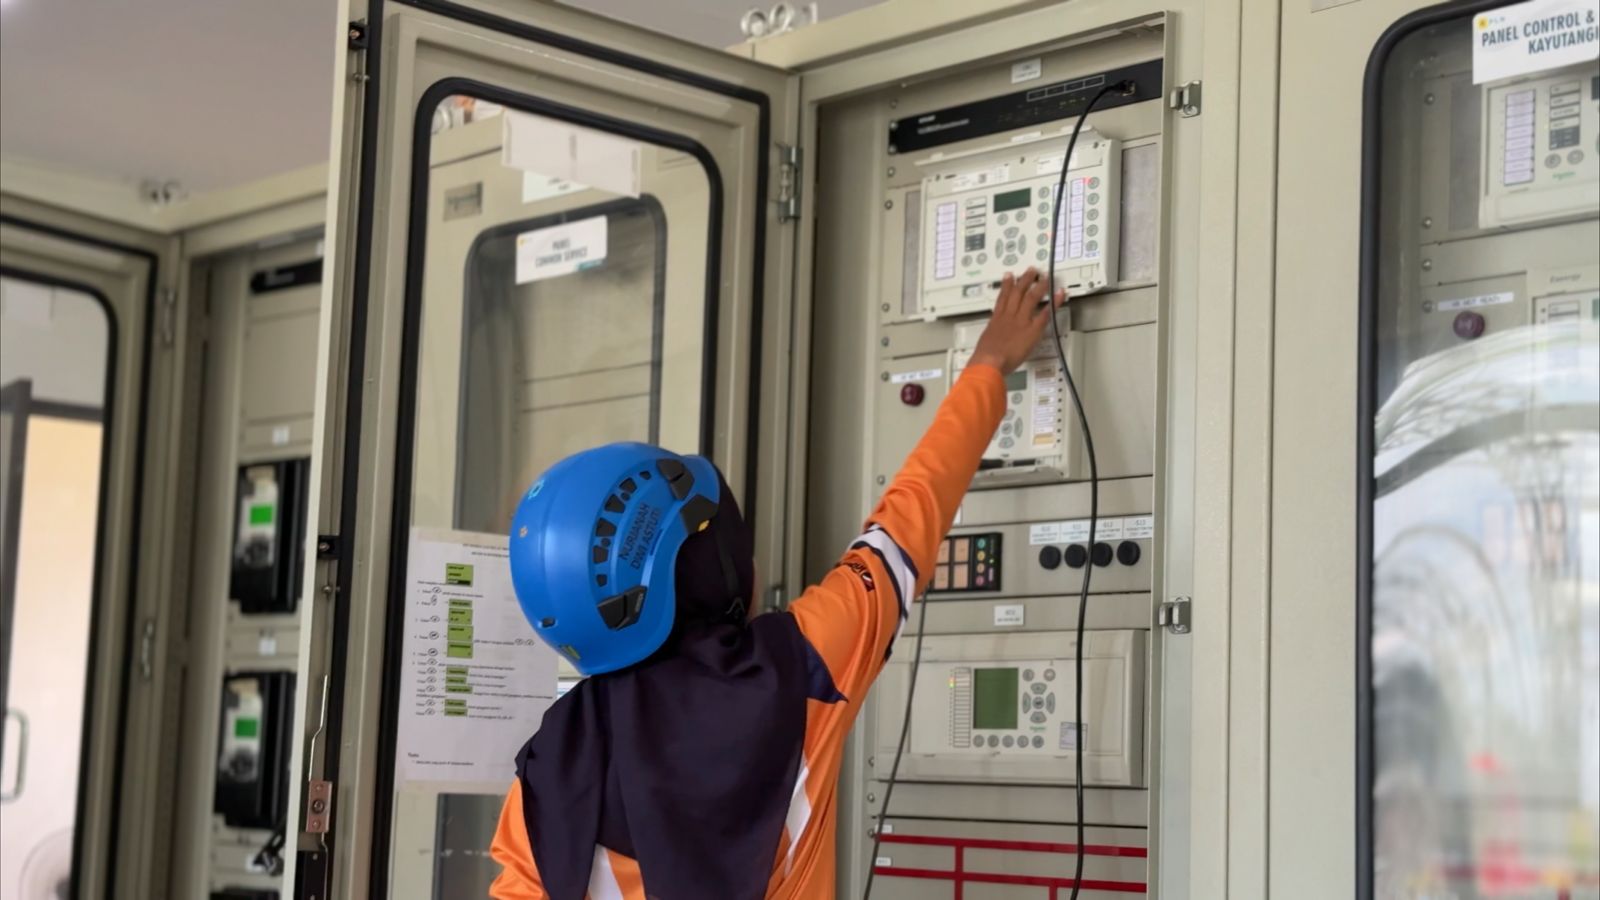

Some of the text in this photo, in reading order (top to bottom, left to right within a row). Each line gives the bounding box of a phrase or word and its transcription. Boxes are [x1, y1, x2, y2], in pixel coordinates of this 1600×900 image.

[1482, 10, 1595, 47] PANEL CONTROL &
[630, 543, 648, 570] DWI
